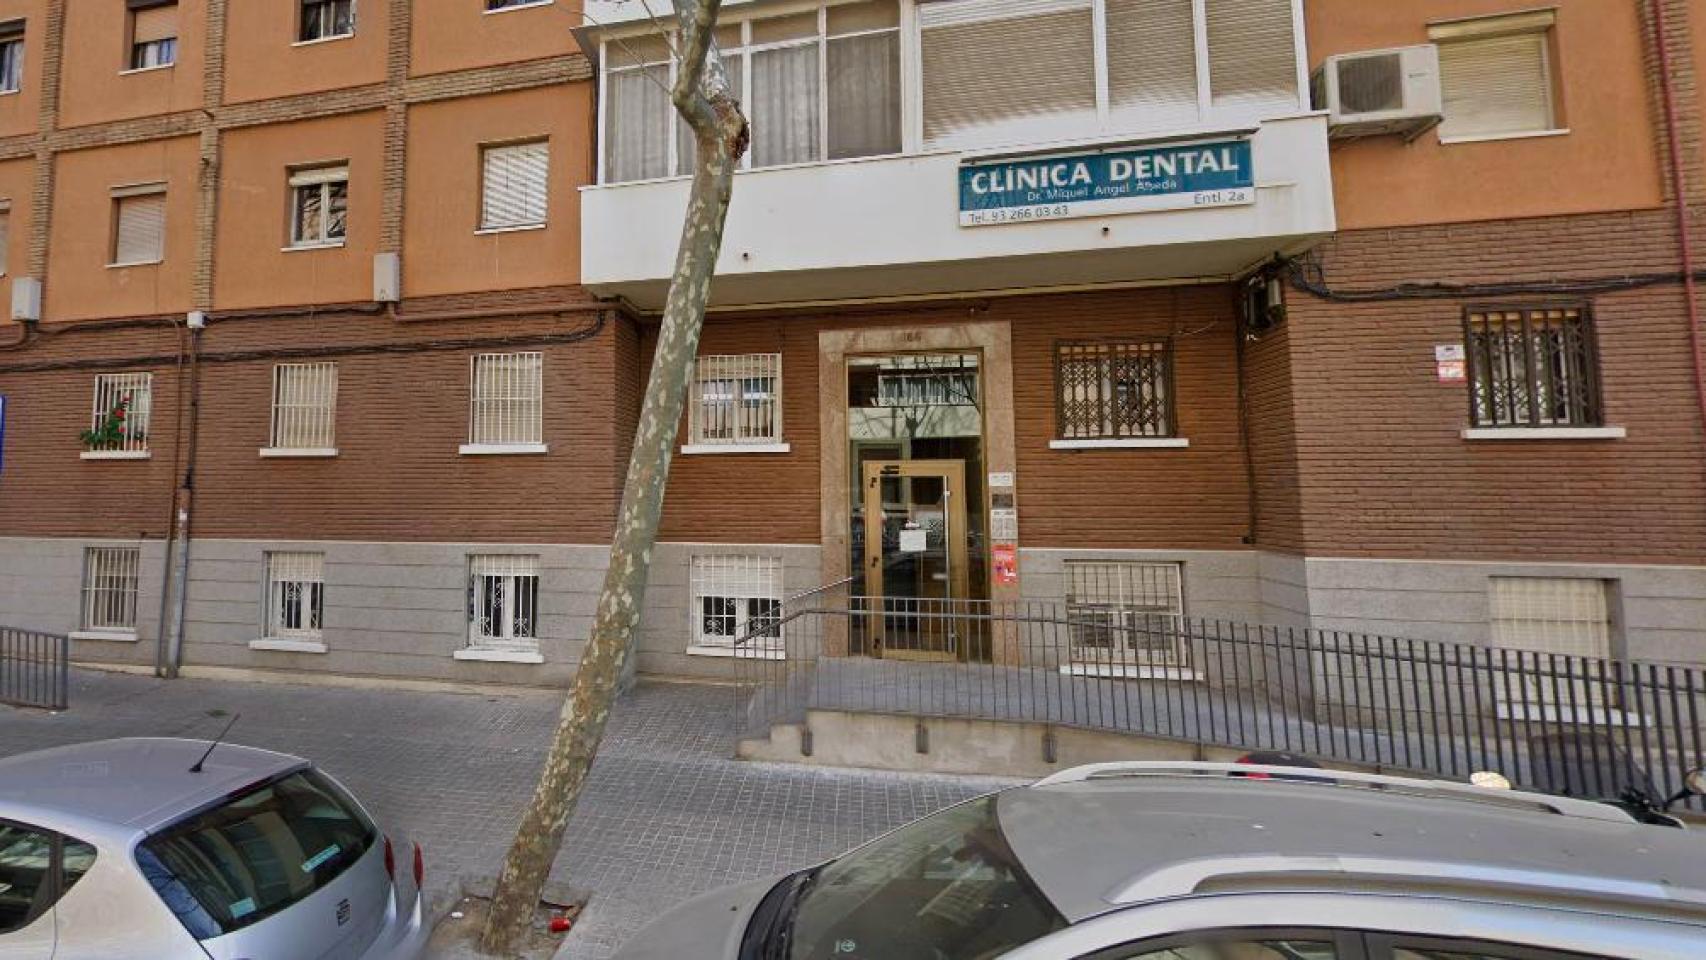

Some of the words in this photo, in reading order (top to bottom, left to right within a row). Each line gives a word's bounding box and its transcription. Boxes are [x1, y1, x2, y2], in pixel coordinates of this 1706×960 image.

[971, 161, 1092, 195] CLÍNICA
[1109, 147, 1239, 182] DENTAL
[992, 210, 1005, 222] 93
[1009, 208, 1032, 220] 266
[1035, 206, 1051, 218] 03
